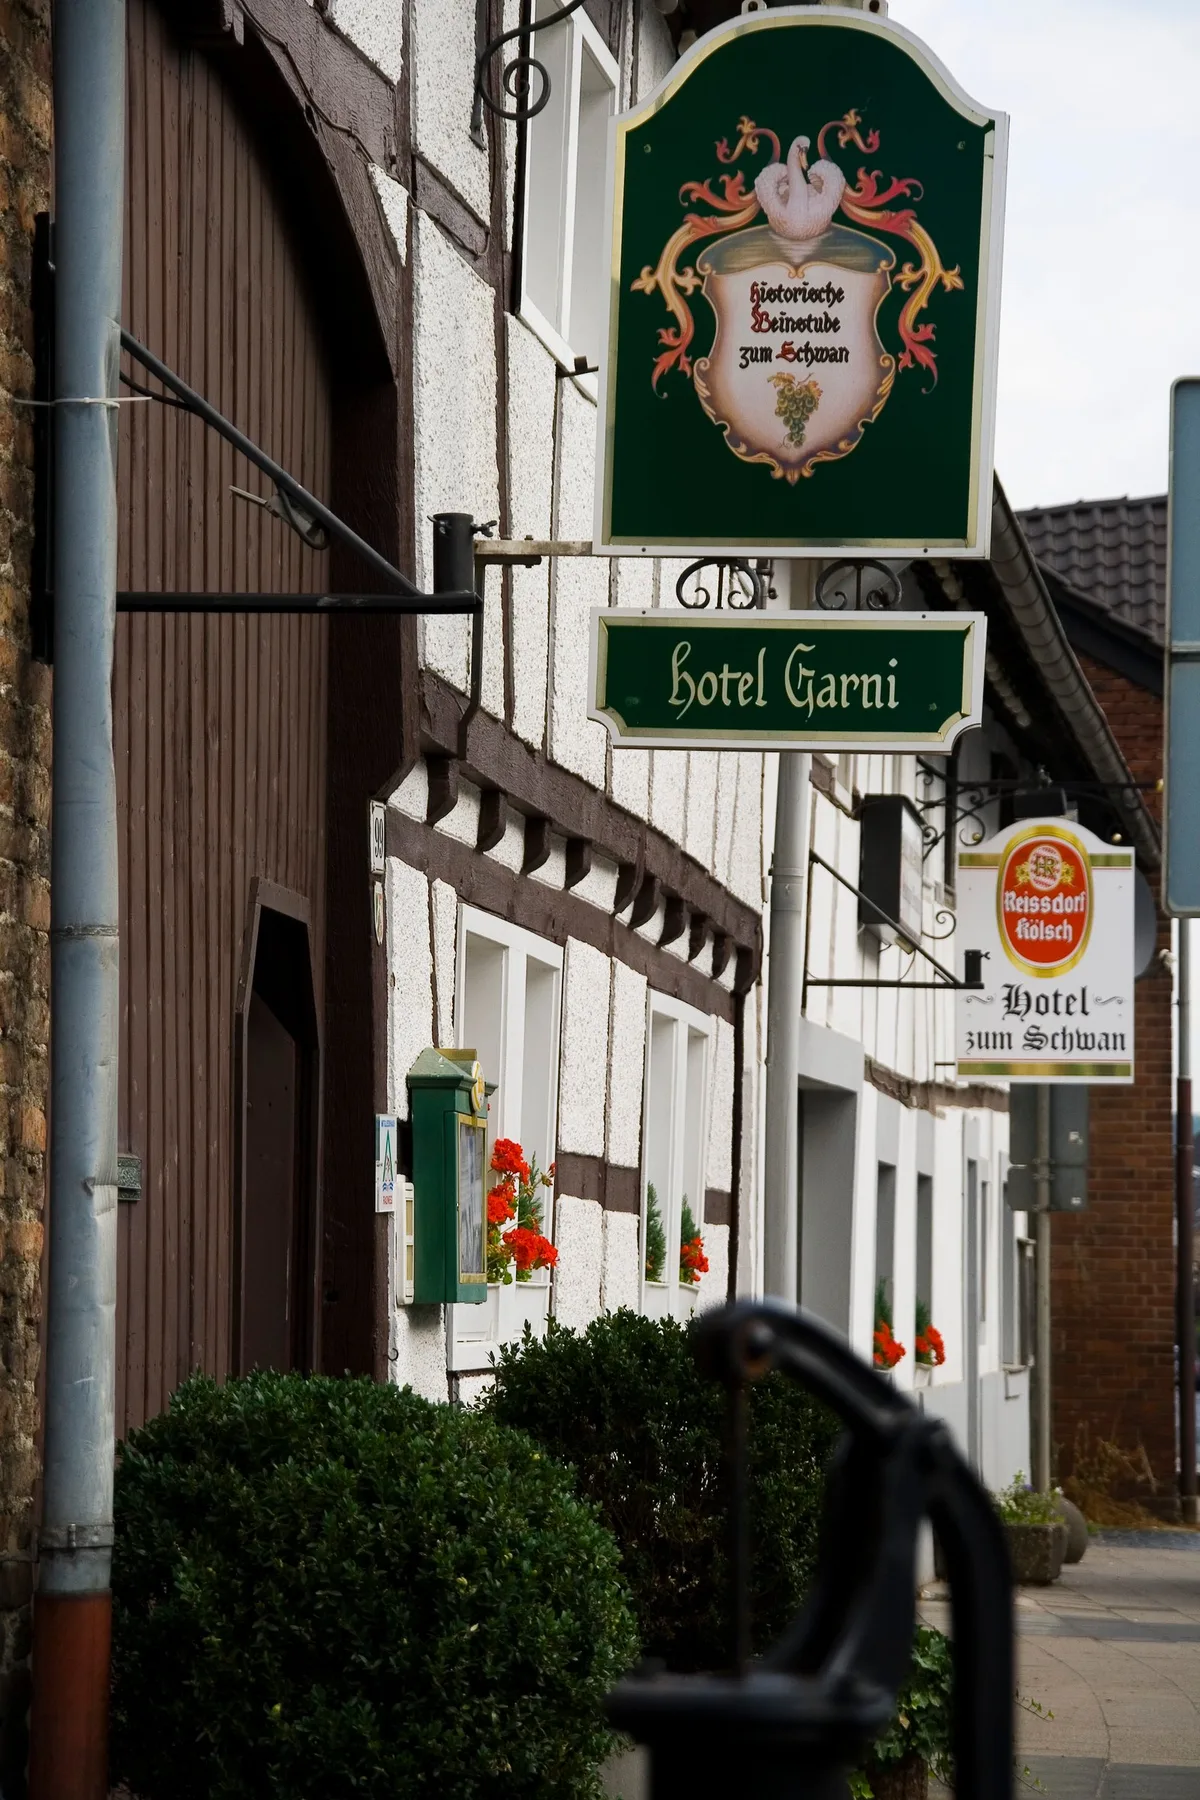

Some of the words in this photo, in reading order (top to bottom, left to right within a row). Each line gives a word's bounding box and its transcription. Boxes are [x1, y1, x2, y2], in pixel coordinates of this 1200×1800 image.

[739, 346, 773, 369] zum
[776, 341, 849, 368] Schwan
[784, 643, 899, 718] Garni
[1004, 890, 1087, 913] Reissdorf
[1015, 917, 1073, 943] Kölsch
[1001, 983, 1090, 1021] Hotel
[965, 1030, 1013, 1055] zum
[1022, 1024, 1126, 1055] Schwan
